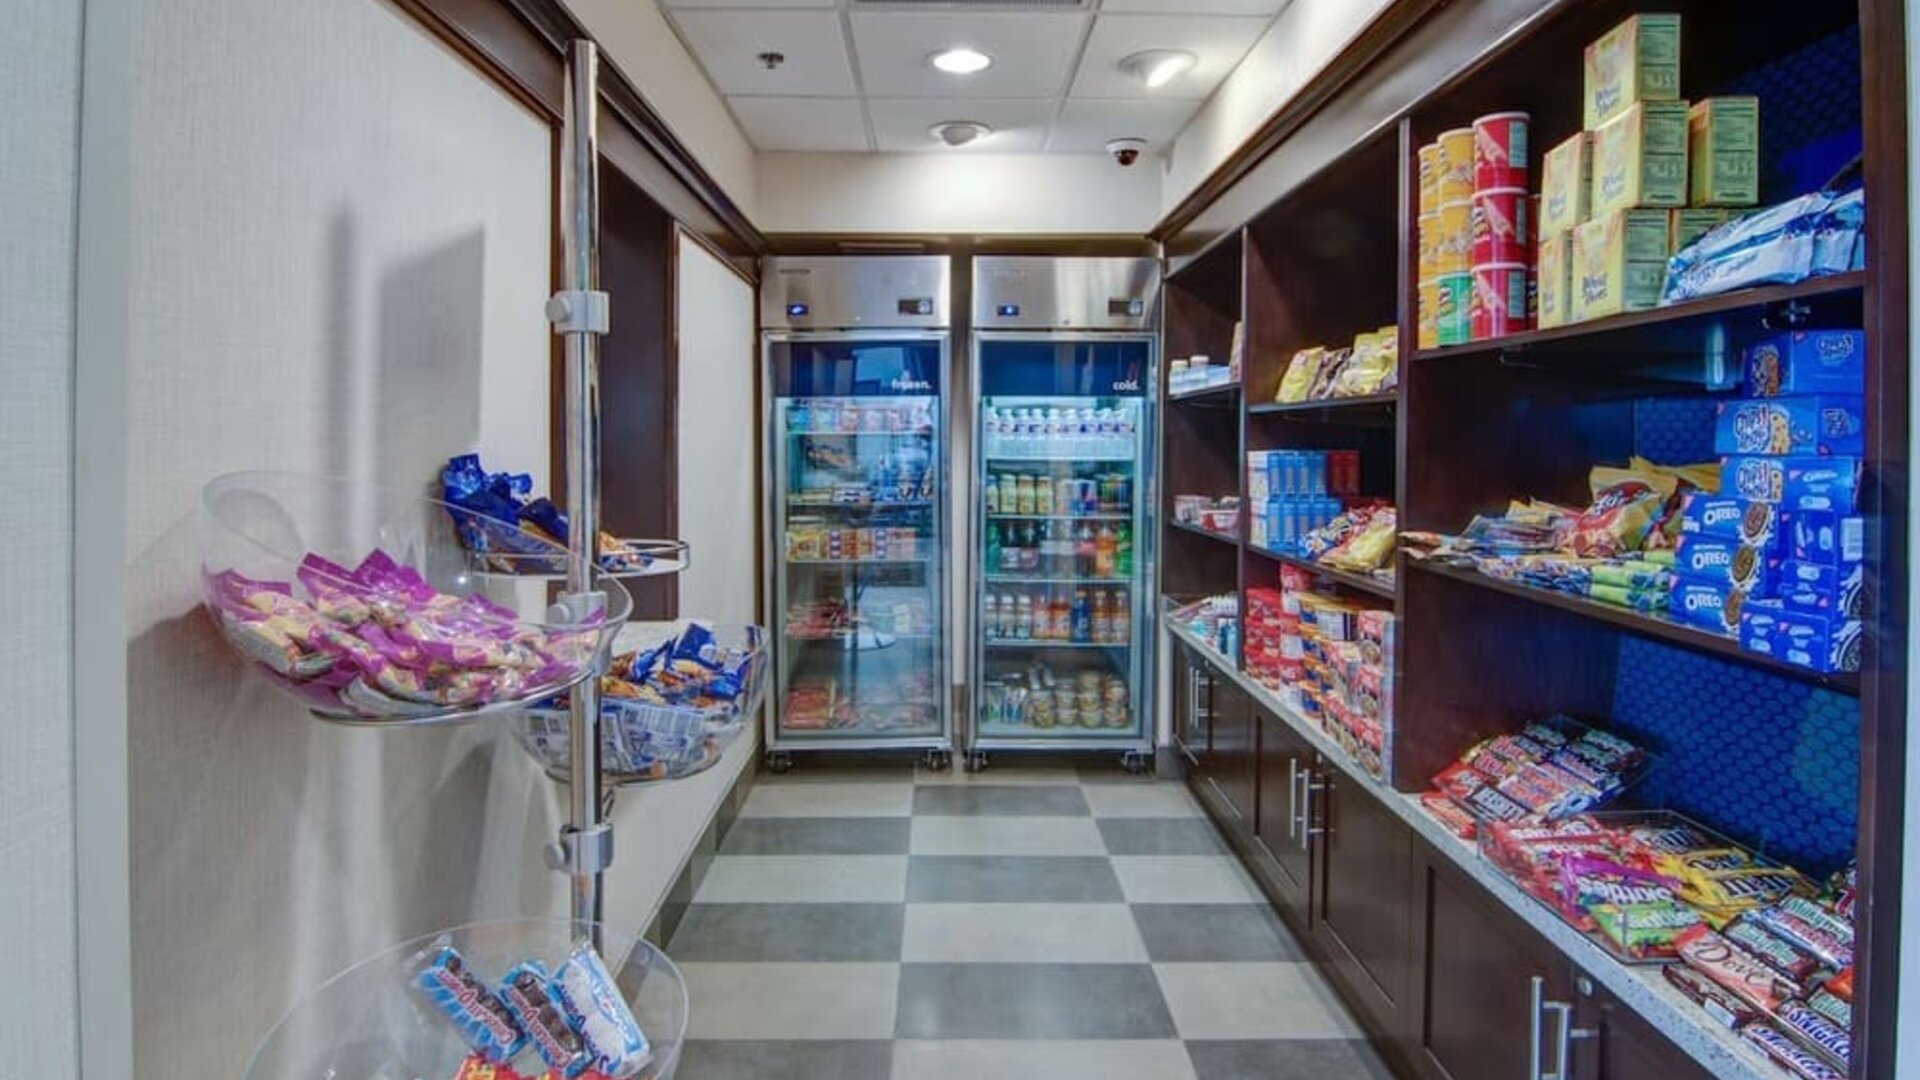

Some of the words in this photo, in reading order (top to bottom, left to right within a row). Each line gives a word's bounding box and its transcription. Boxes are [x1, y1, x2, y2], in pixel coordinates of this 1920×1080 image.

[1704, 507, 1741, 525] OREO
[1692, 552, 1730, 570] OREO
[1685, 593, 1722, 611] OREO
[1694, 942, 1766, 984] Dove
